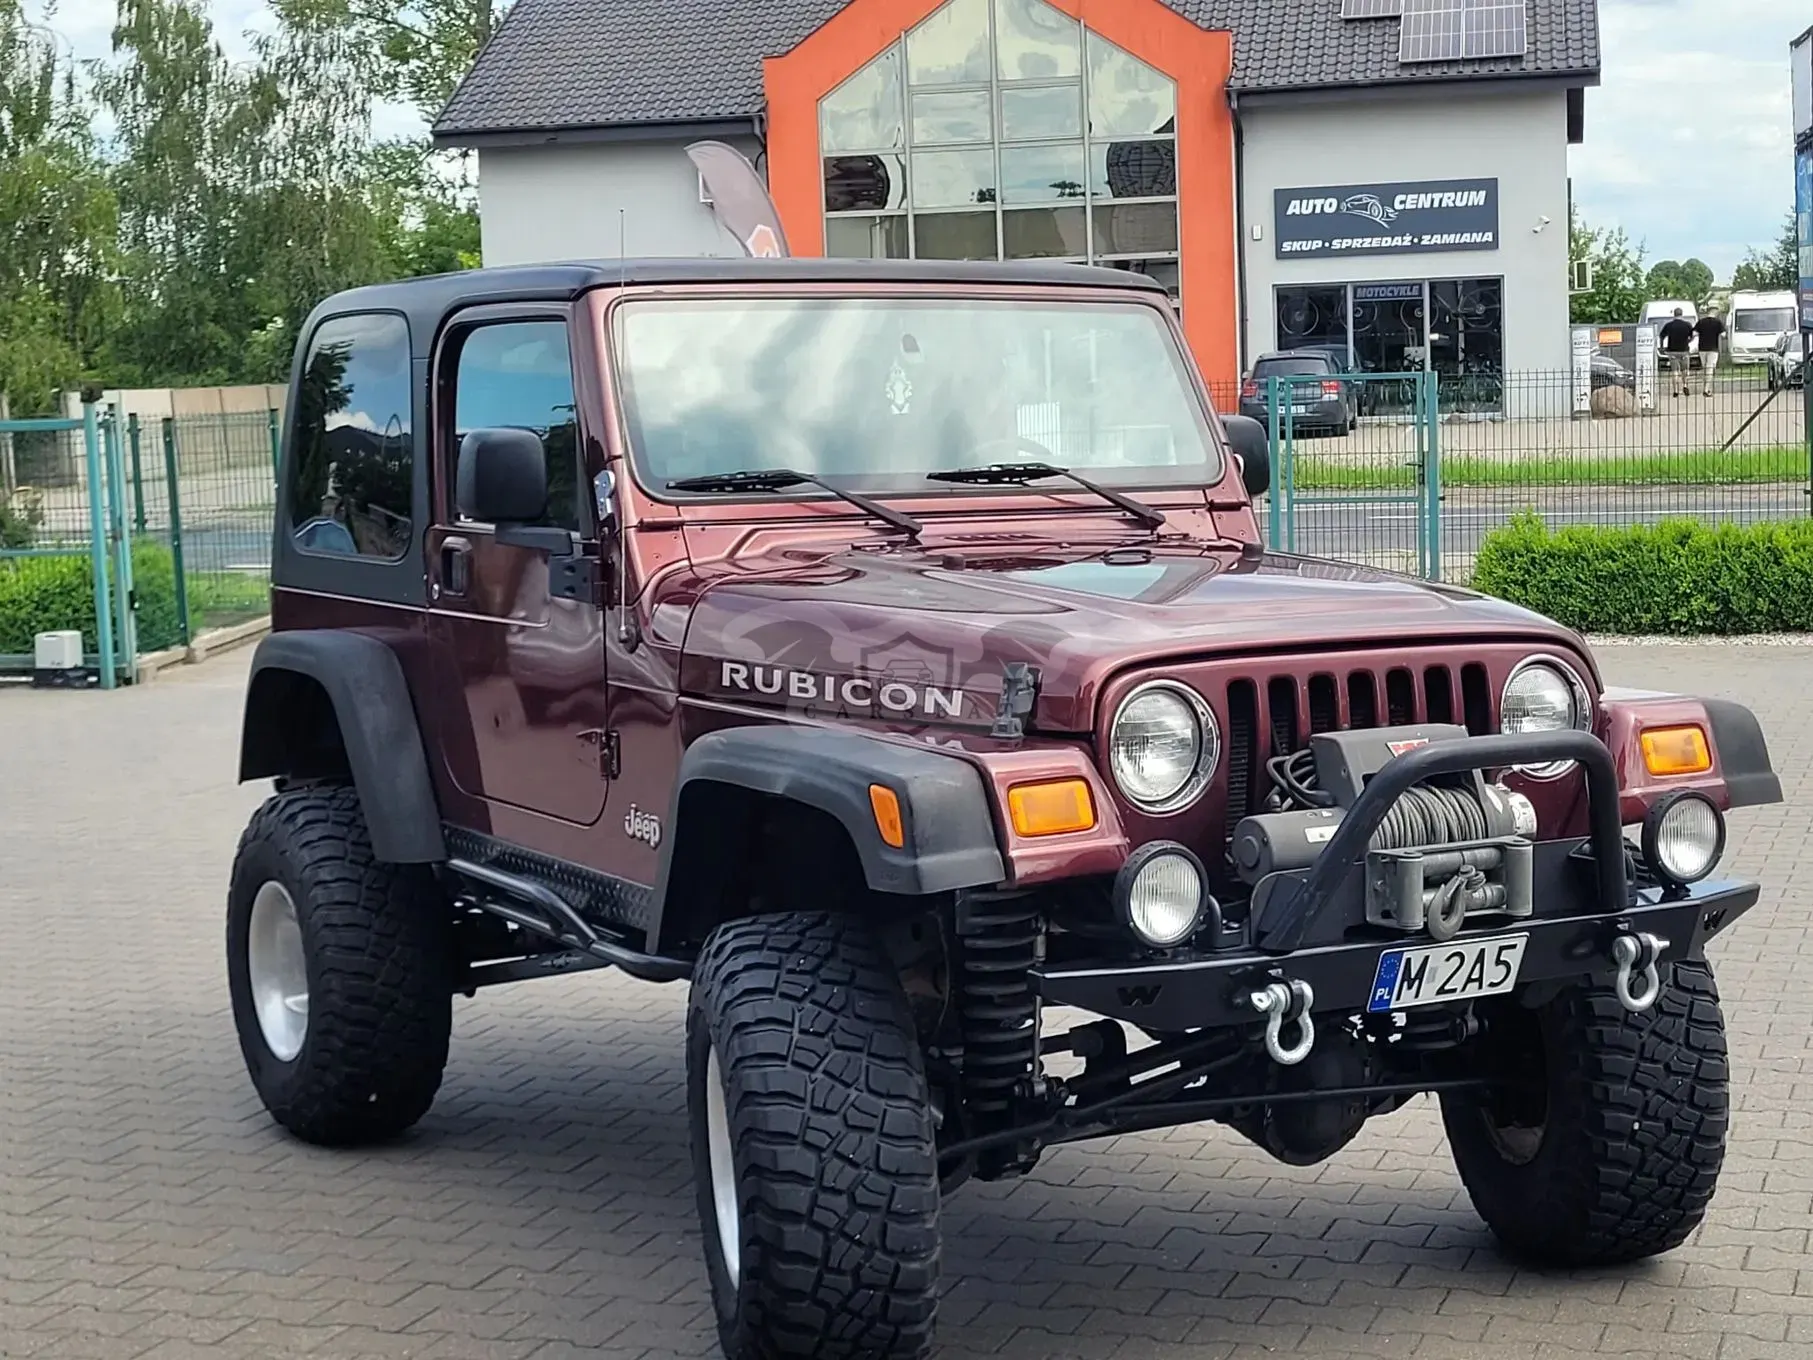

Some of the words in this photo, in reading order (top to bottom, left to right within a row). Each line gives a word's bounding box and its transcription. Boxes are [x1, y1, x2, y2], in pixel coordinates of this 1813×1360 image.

[1285, 197, 1338, 216] AUTO
[1393, 190, 1486, 211] CENTRUM
[1281, 239, 1323, 252] SKUP
[1330, 233, 1413, 250] SPRZEDAŻ
[1420, 231, 1494, 246] ZAMIANA
[721, 661, 963, 717] RUBICON
[1395, 953, 1431, 1002] M
[1435, 943, 1519, 997] 2A5
[1375, 987, 1391, 1002] PL
